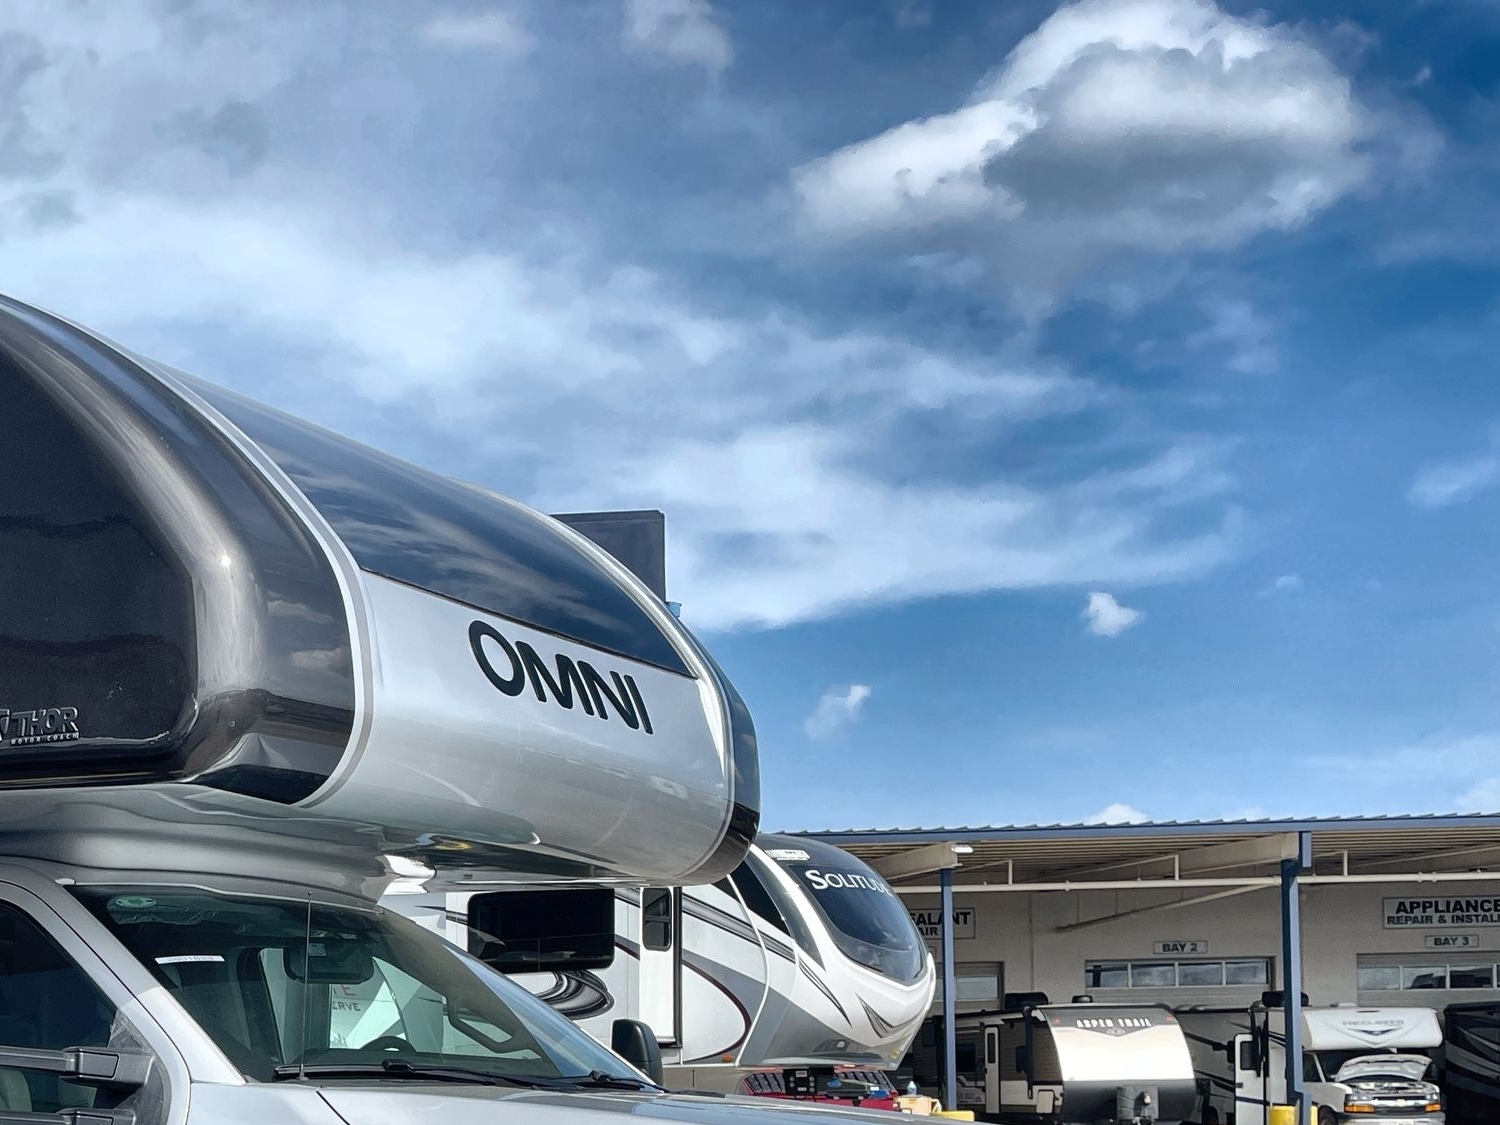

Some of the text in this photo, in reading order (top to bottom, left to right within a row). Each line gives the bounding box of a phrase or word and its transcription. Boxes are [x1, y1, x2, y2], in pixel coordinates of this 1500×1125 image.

[468, 620, 654, 735] OMNI
[11, 706, 80, 738] THOR
[11, 732, 79, 745] MOTOR COACH
[1395, 900, 1500, 914] APPLIANCE
[1386, 915, 1433, 925] REPAIR
[1437, 915, 1447, 924] &
[1162, 943, 1198, 953] BAY 2
[1434, 937, 1469, 946] BAY 3
